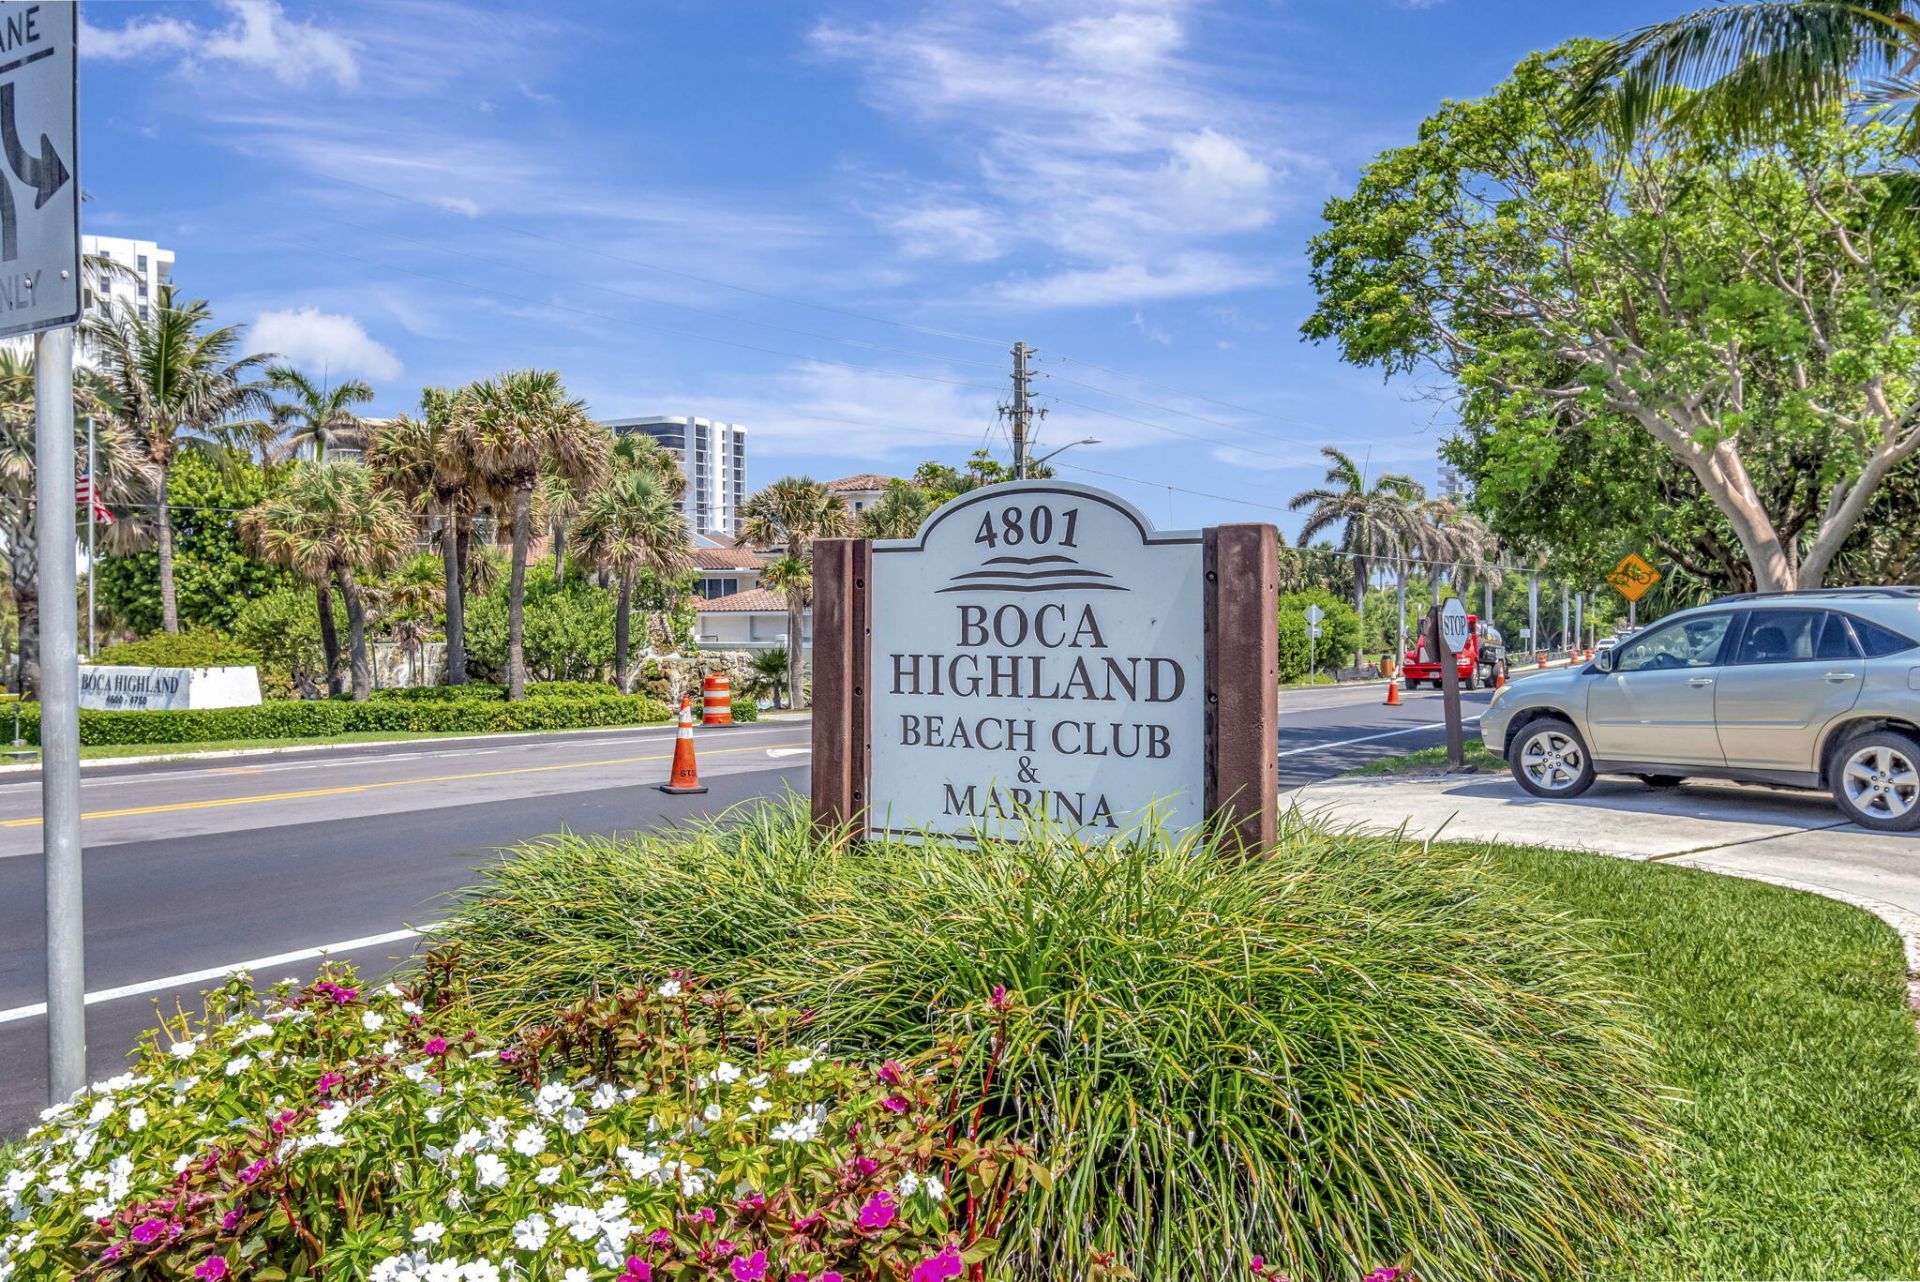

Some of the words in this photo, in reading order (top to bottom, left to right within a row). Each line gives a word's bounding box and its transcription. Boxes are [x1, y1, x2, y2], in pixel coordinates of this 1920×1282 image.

[974, 504, 1079, 549] 4801
[956, 603, 1109, 649] BOCA
[1444, 615, 1466, 636] STOP
[81, 674, 111, 692] BOCA
[114, 674, 179, 694] HIGHLAND
[889, 653, 1186, 703] HIGHLAND
[900, 714, 1037, 752] BEACH
[1051, 720, 1172, 759] CLUB
[1017, 755, 1041, 784] &
[943, 783, 1119, 829] MARINA
